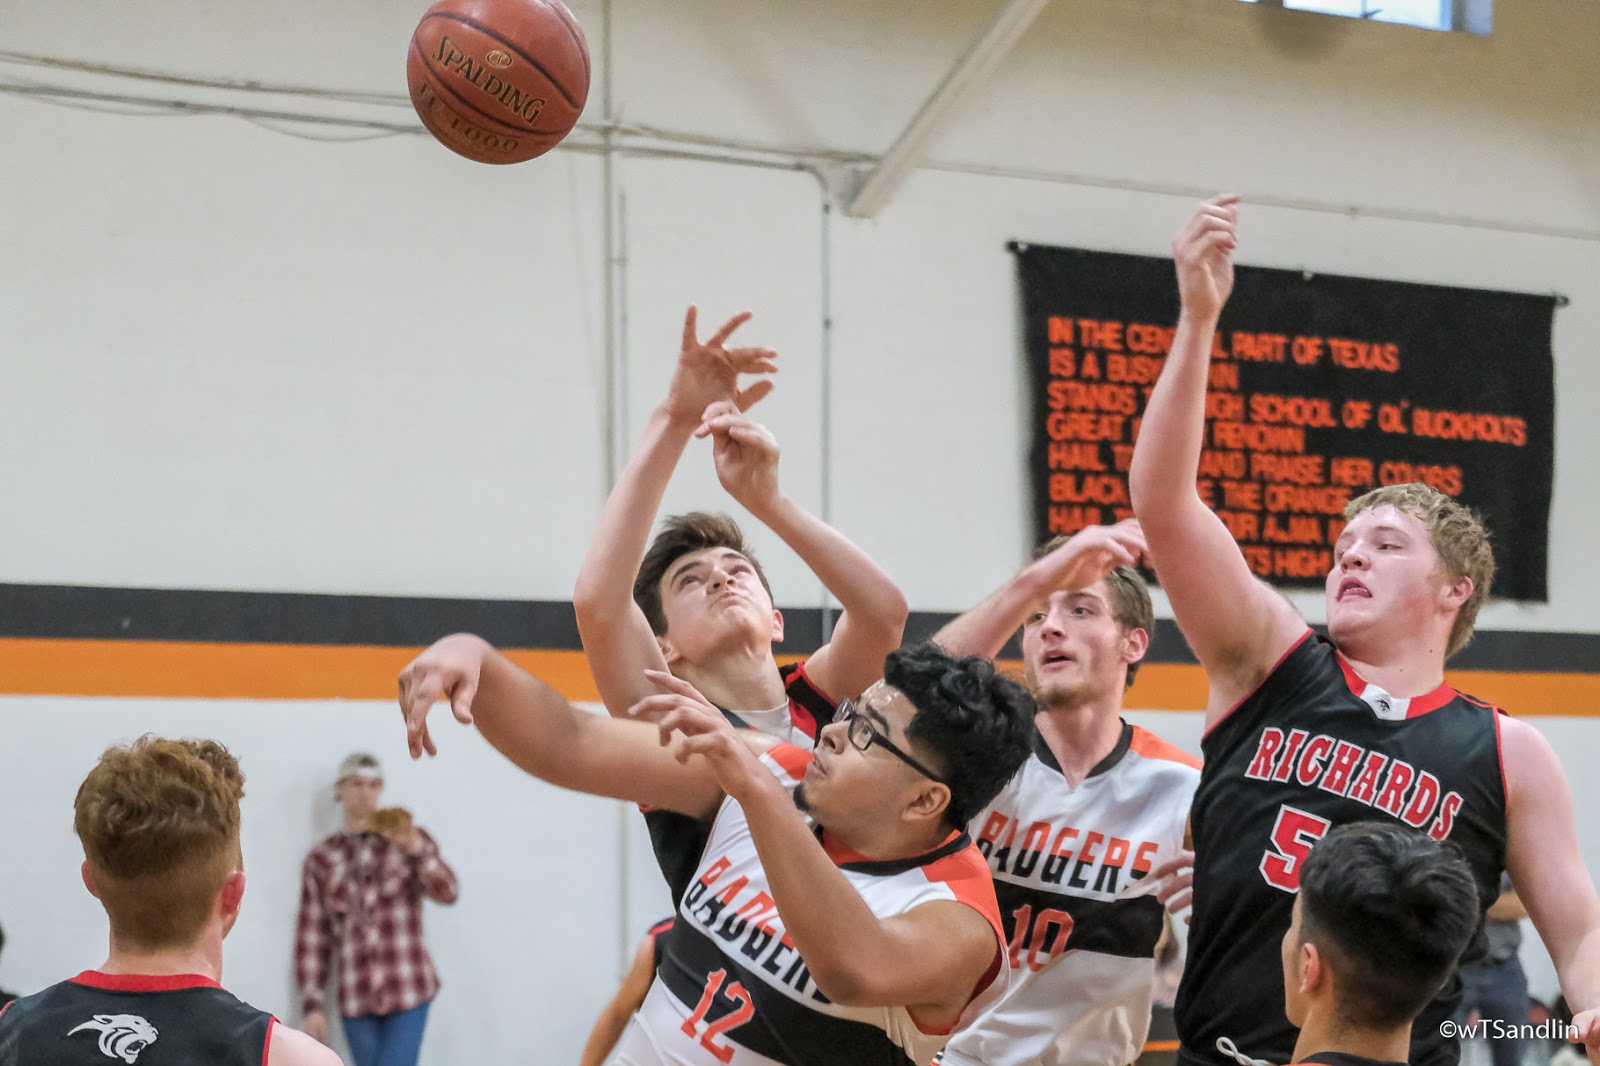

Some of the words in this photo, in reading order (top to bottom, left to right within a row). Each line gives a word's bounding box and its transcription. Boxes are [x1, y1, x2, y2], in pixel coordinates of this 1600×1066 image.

[431, 34, 546, 126] SPALDING
[1049, 316, 1073, 344] IN
[1079, 320, 1123, 349] THE
[1232, 333, 1286, 361] PART
[1292, 336, 1323, 365] OF
[1328, 338, 1398, 372] TEXAS
[1050, 349, 1075, 377] IS
[1081, 352, 1099, 379] A
[1048, 381, 1137, 415] STANDS
[1251, 394, 1336, 427] SCHOOL
[1342, 402, 1370, 428] OF
[1048, 412, 1125, 441] GREAT
[1049, 441, 1104, 470] HAIL
[1332, 457, 1373, 485] HER
[1379, 461, 1462, 496] CORS
[1244, 727, 1464, 841] RICHARDS
[976, 811, 1159, 894] BADGERS
[684, 855, 833, 1005] BADGE
[1008, 903, 1075, 973] 10
[680, 968, 756, 1064] 12
